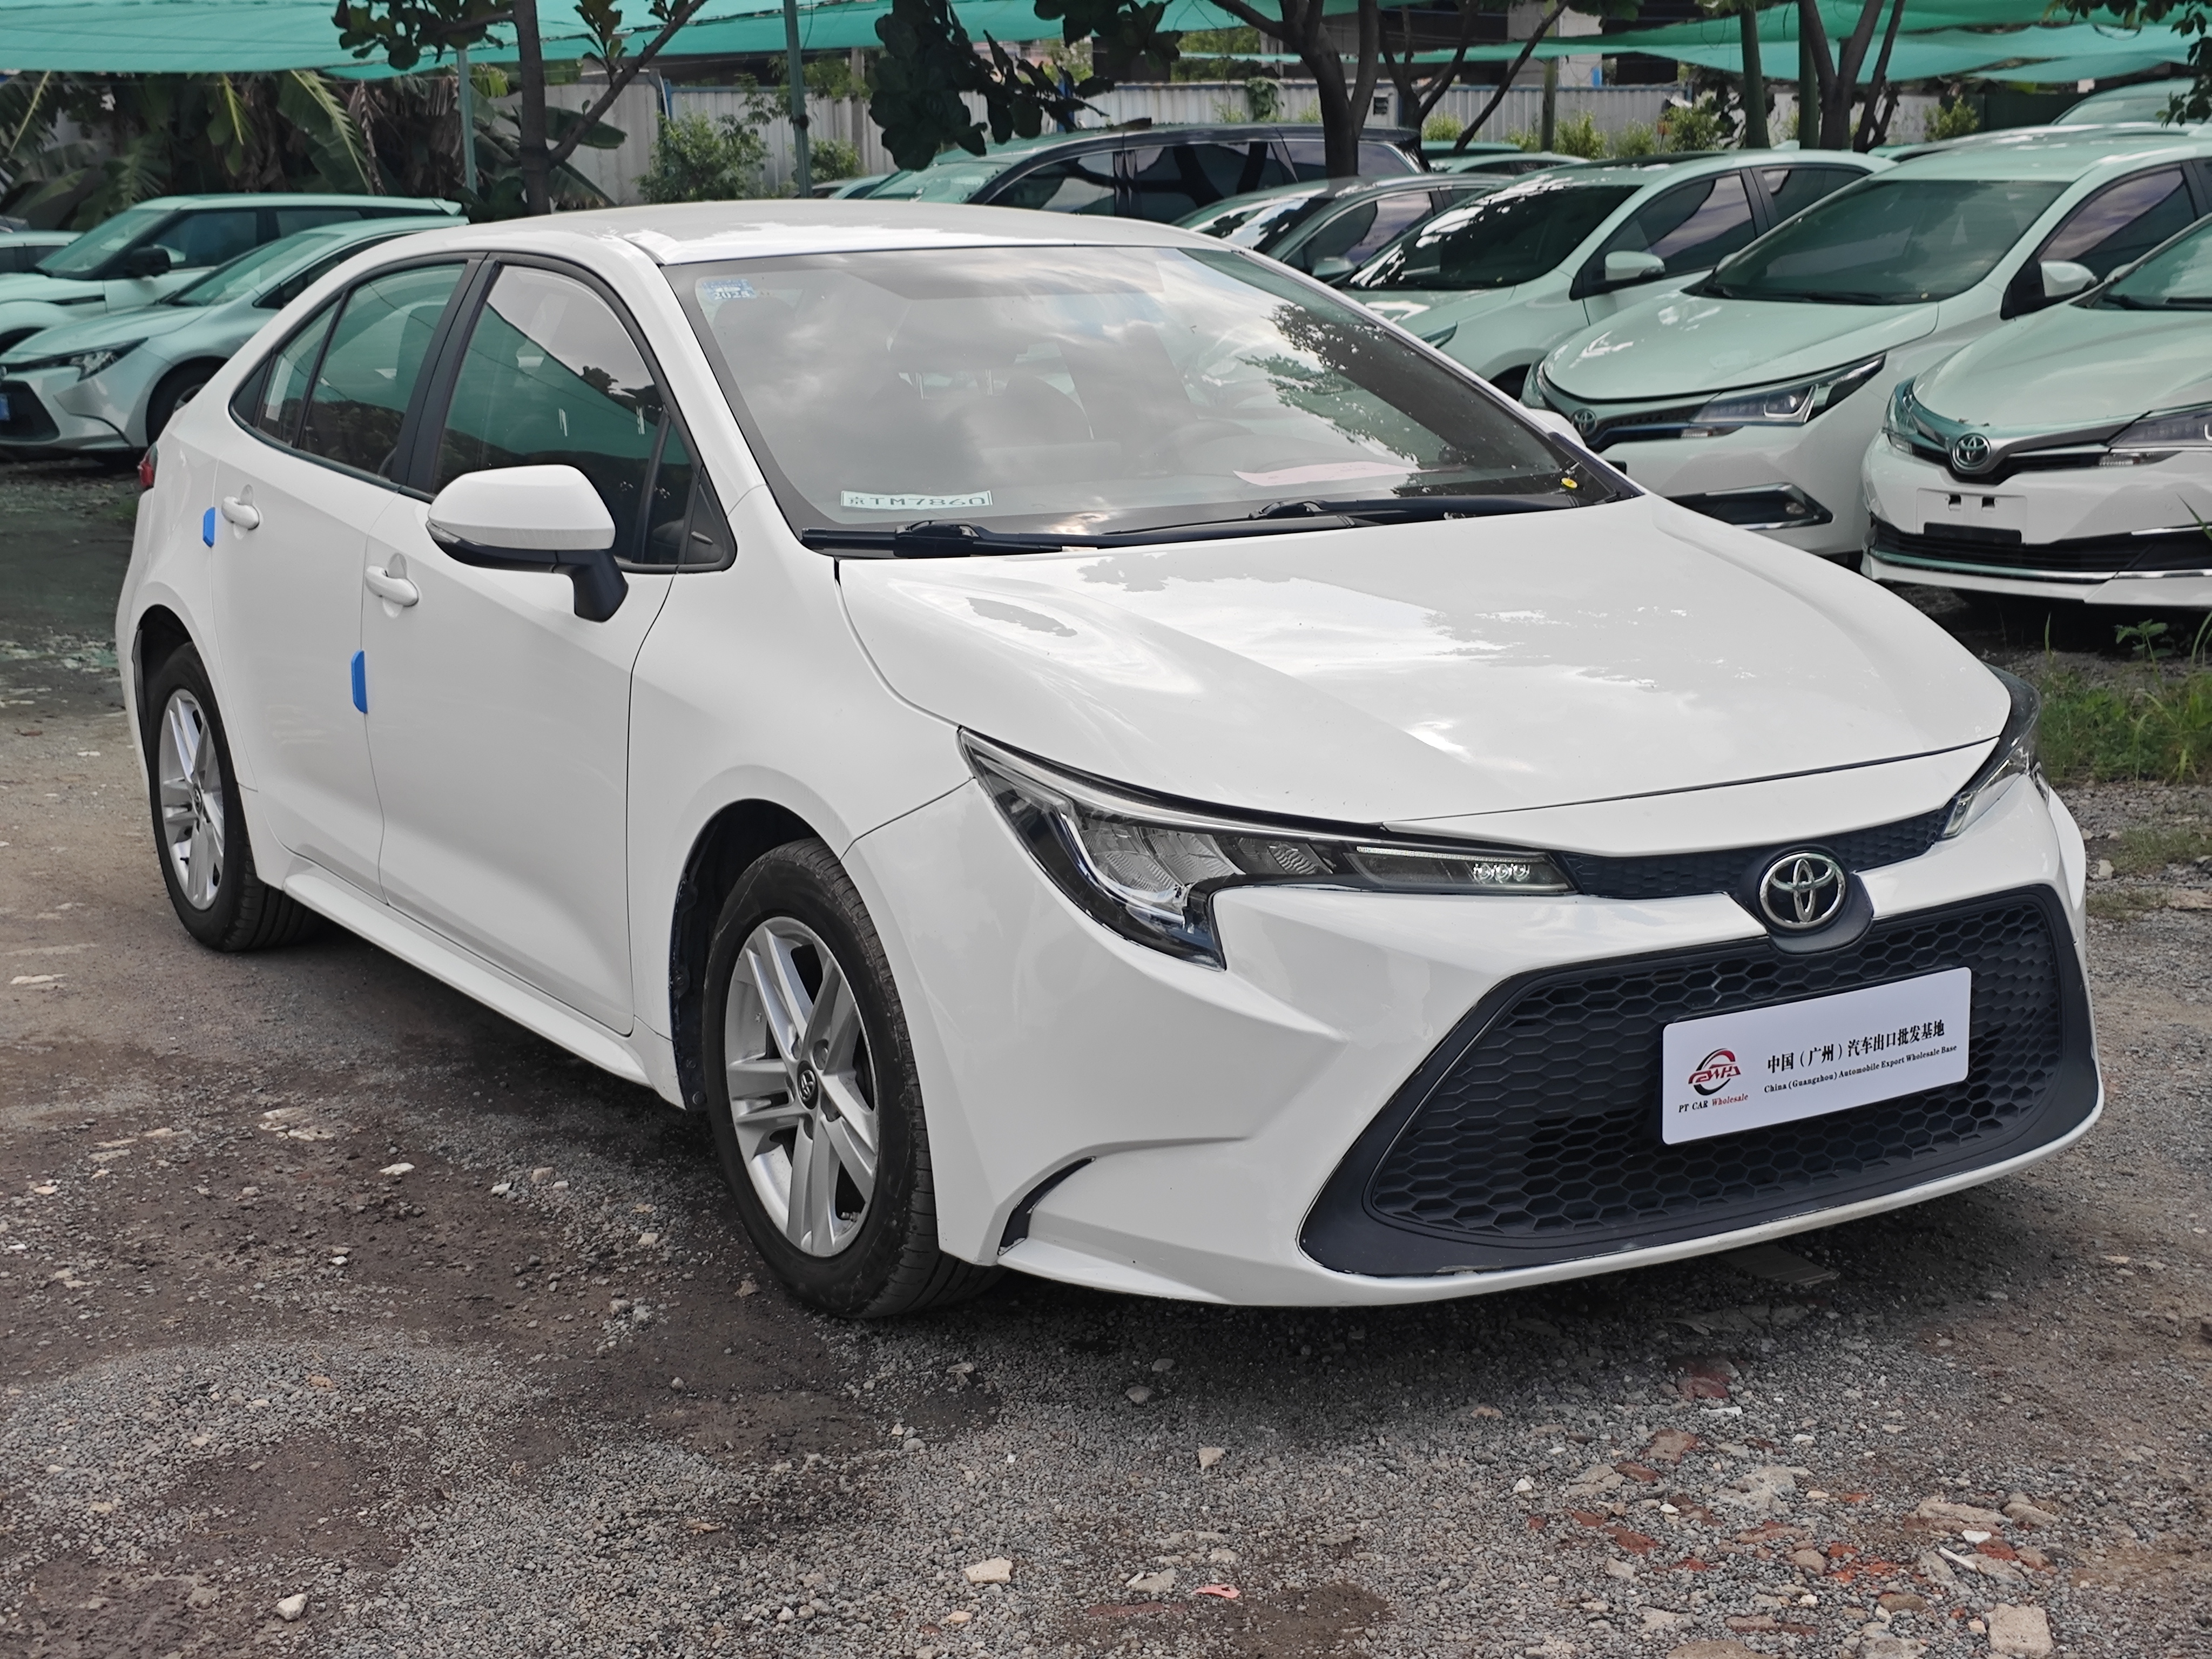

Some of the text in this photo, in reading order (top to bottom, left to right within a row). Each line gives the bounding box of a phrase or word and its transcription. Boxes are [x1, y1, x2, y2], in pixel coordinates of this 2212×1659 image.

[1764, 1045, 1957, 1092] China (Guangzhou) Automobile Export Wholesale Base
[1768, 1019, 1945, 1074] 中国（广州）汽车出口批发基地
[1678, 1093, 1748, 1113] PT CAR Wholesale
